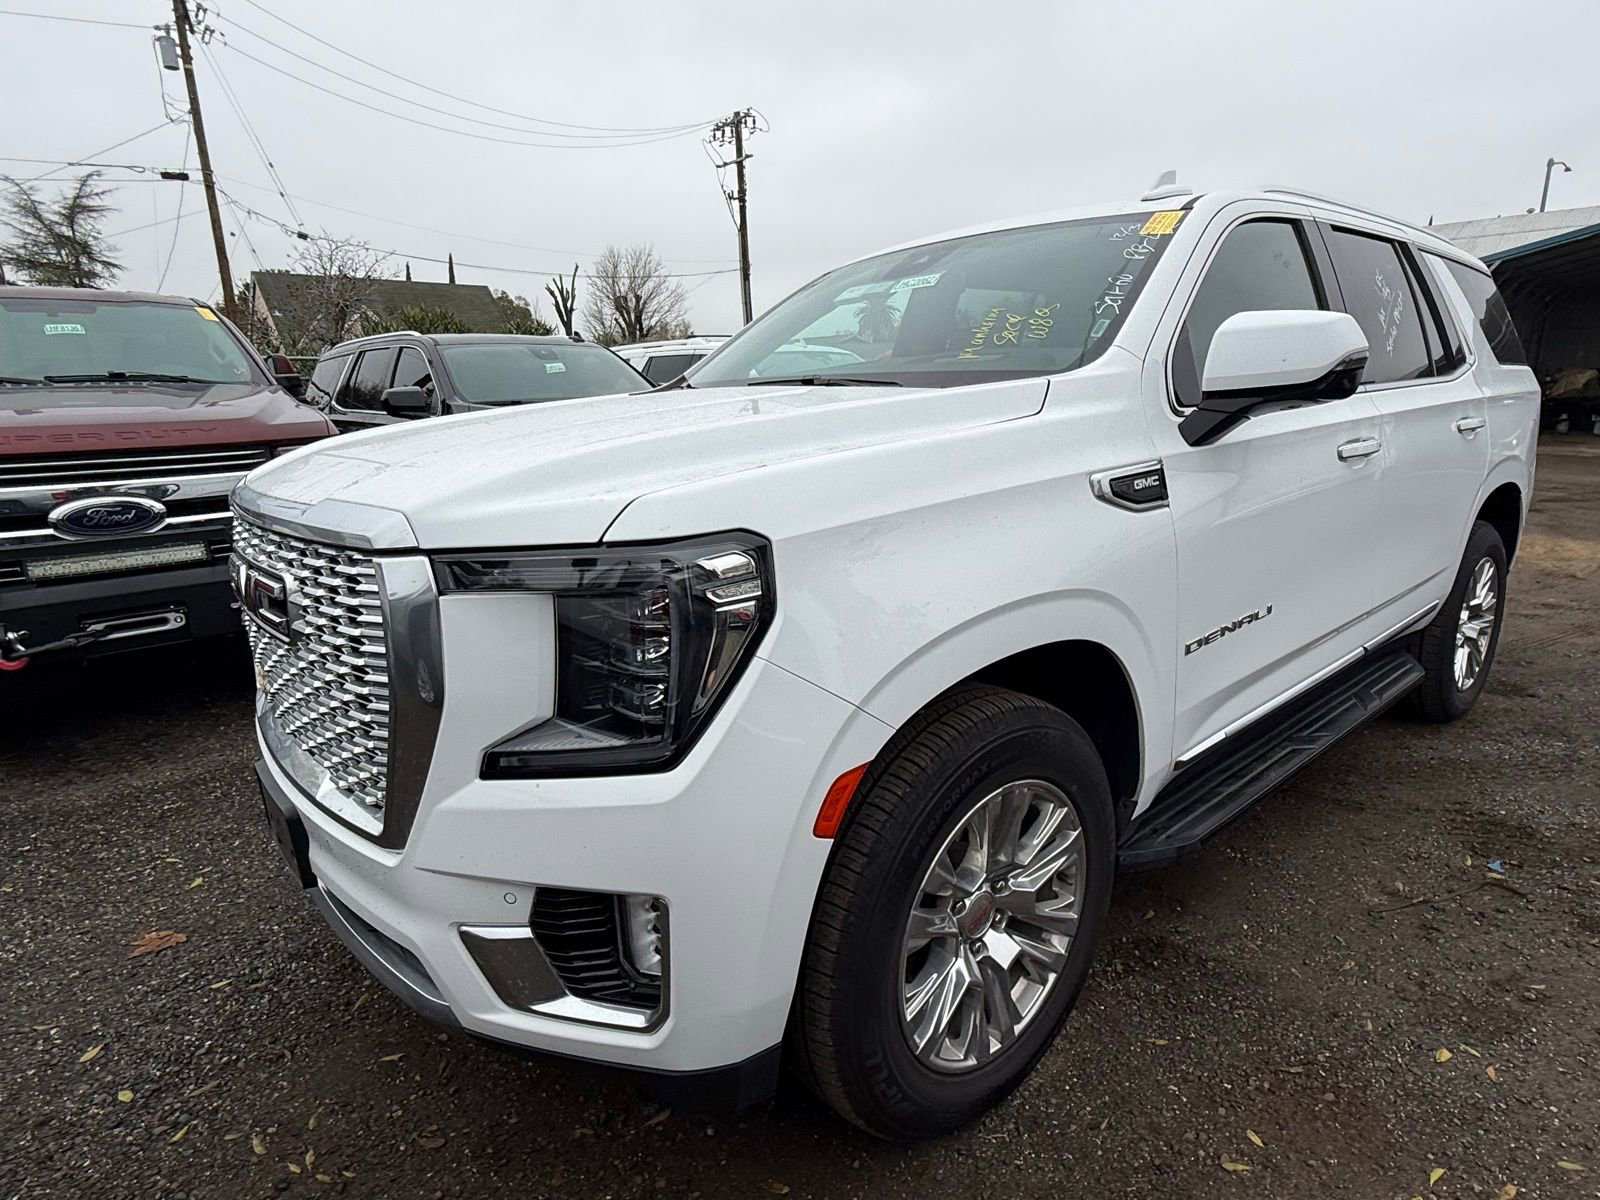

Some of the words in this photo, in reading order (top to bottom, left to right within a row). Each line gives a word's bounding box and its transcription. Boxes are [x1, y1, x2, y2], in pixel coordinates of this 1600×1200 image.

[1133, 475, 1160, 490] GMC
[82, 507, 137, 526] Ford
[1184, 602, 1273, 656] DENALI
